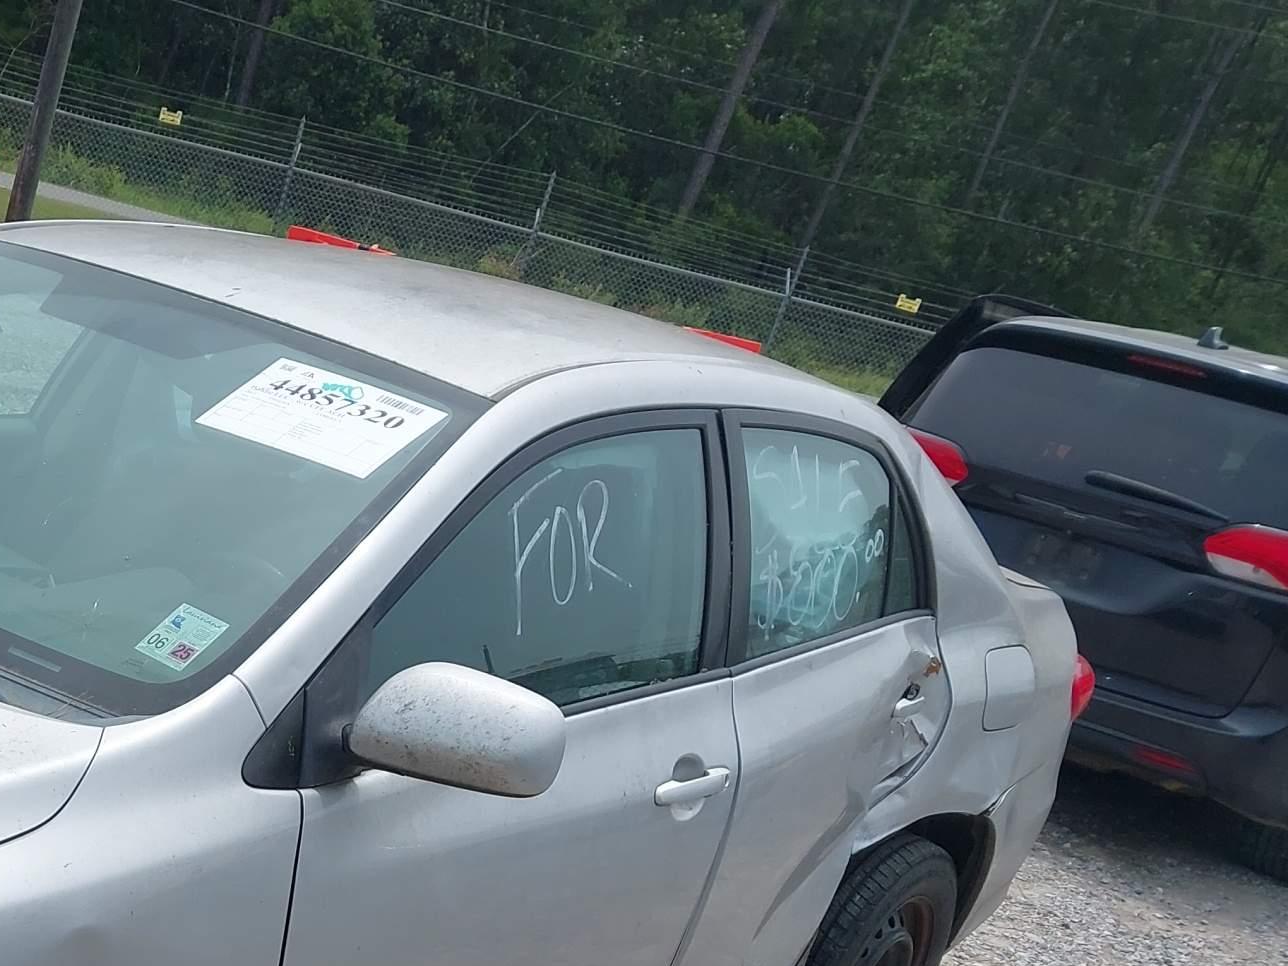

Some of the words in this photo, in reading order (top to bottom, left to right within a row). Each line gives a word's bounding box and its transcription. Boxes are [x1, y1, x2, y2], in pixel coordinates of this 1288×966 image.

[269, 379, 405, 429] 44857320
[508, 468, 633, 636] FOR
[147, 633, 169, 649] 06
[171, 643, 195, 660] 25
